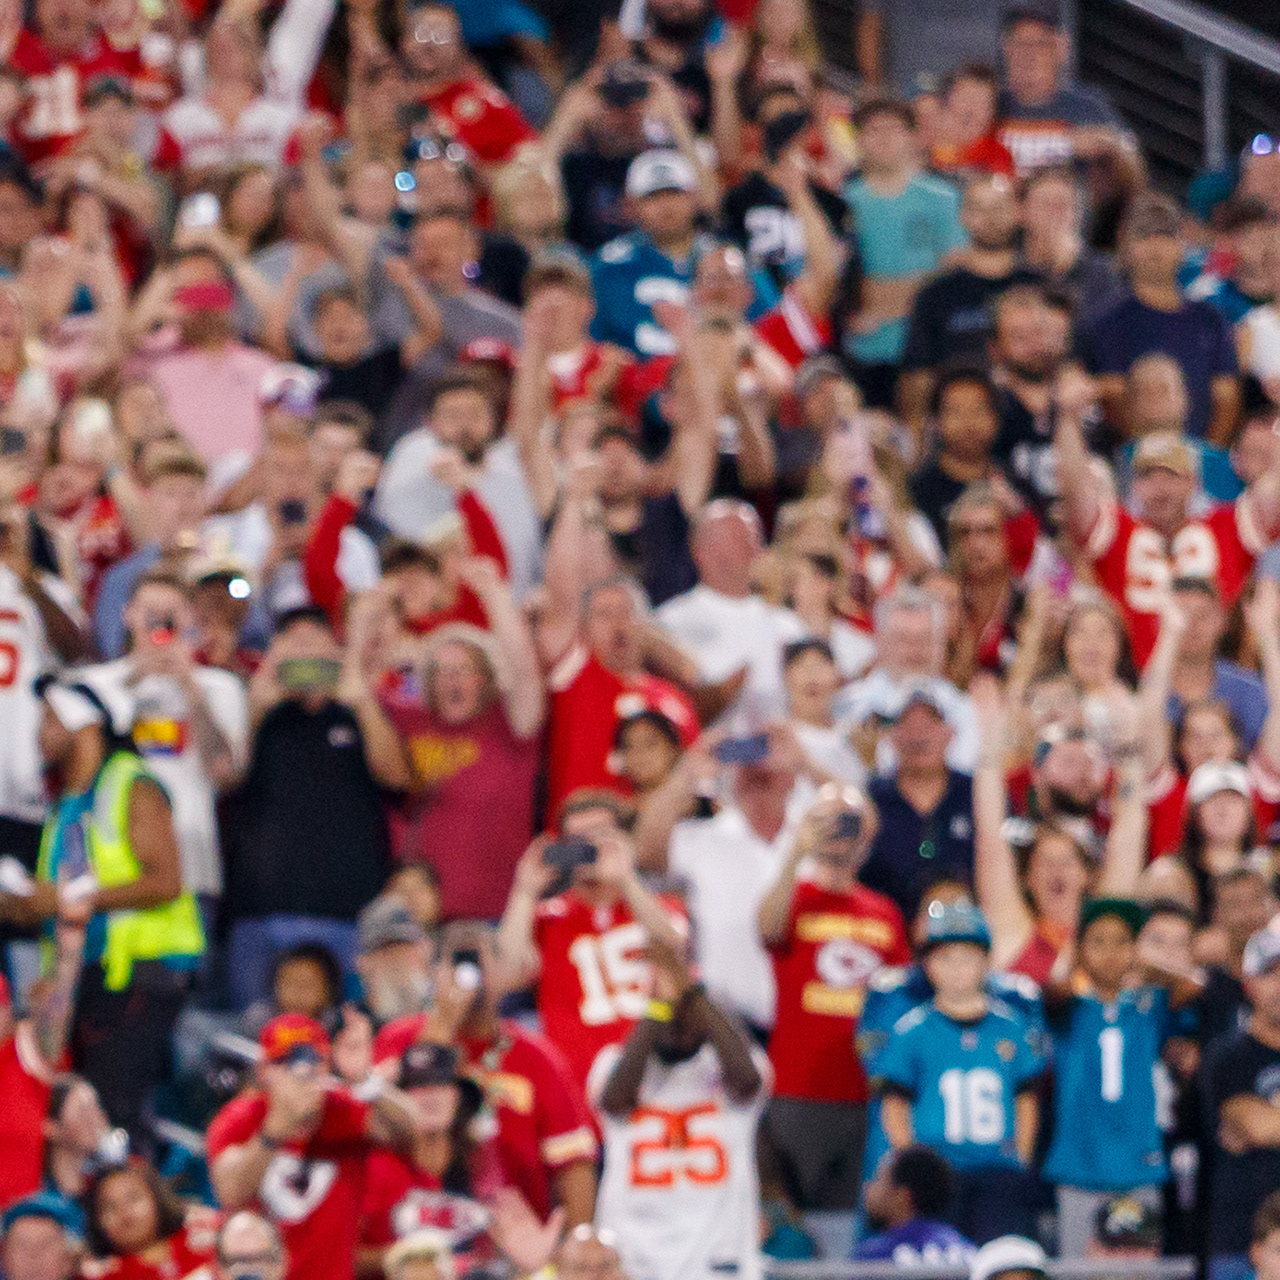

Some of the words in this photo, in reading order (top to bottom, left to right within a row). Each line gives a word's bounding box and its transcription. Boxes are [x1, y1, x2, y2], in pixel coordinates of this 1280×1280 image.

[1099, 1028, 1122, 1102] 1
[630, 1102, 728, 1189] 25
[937, 1069, 1002, 1146] 16
